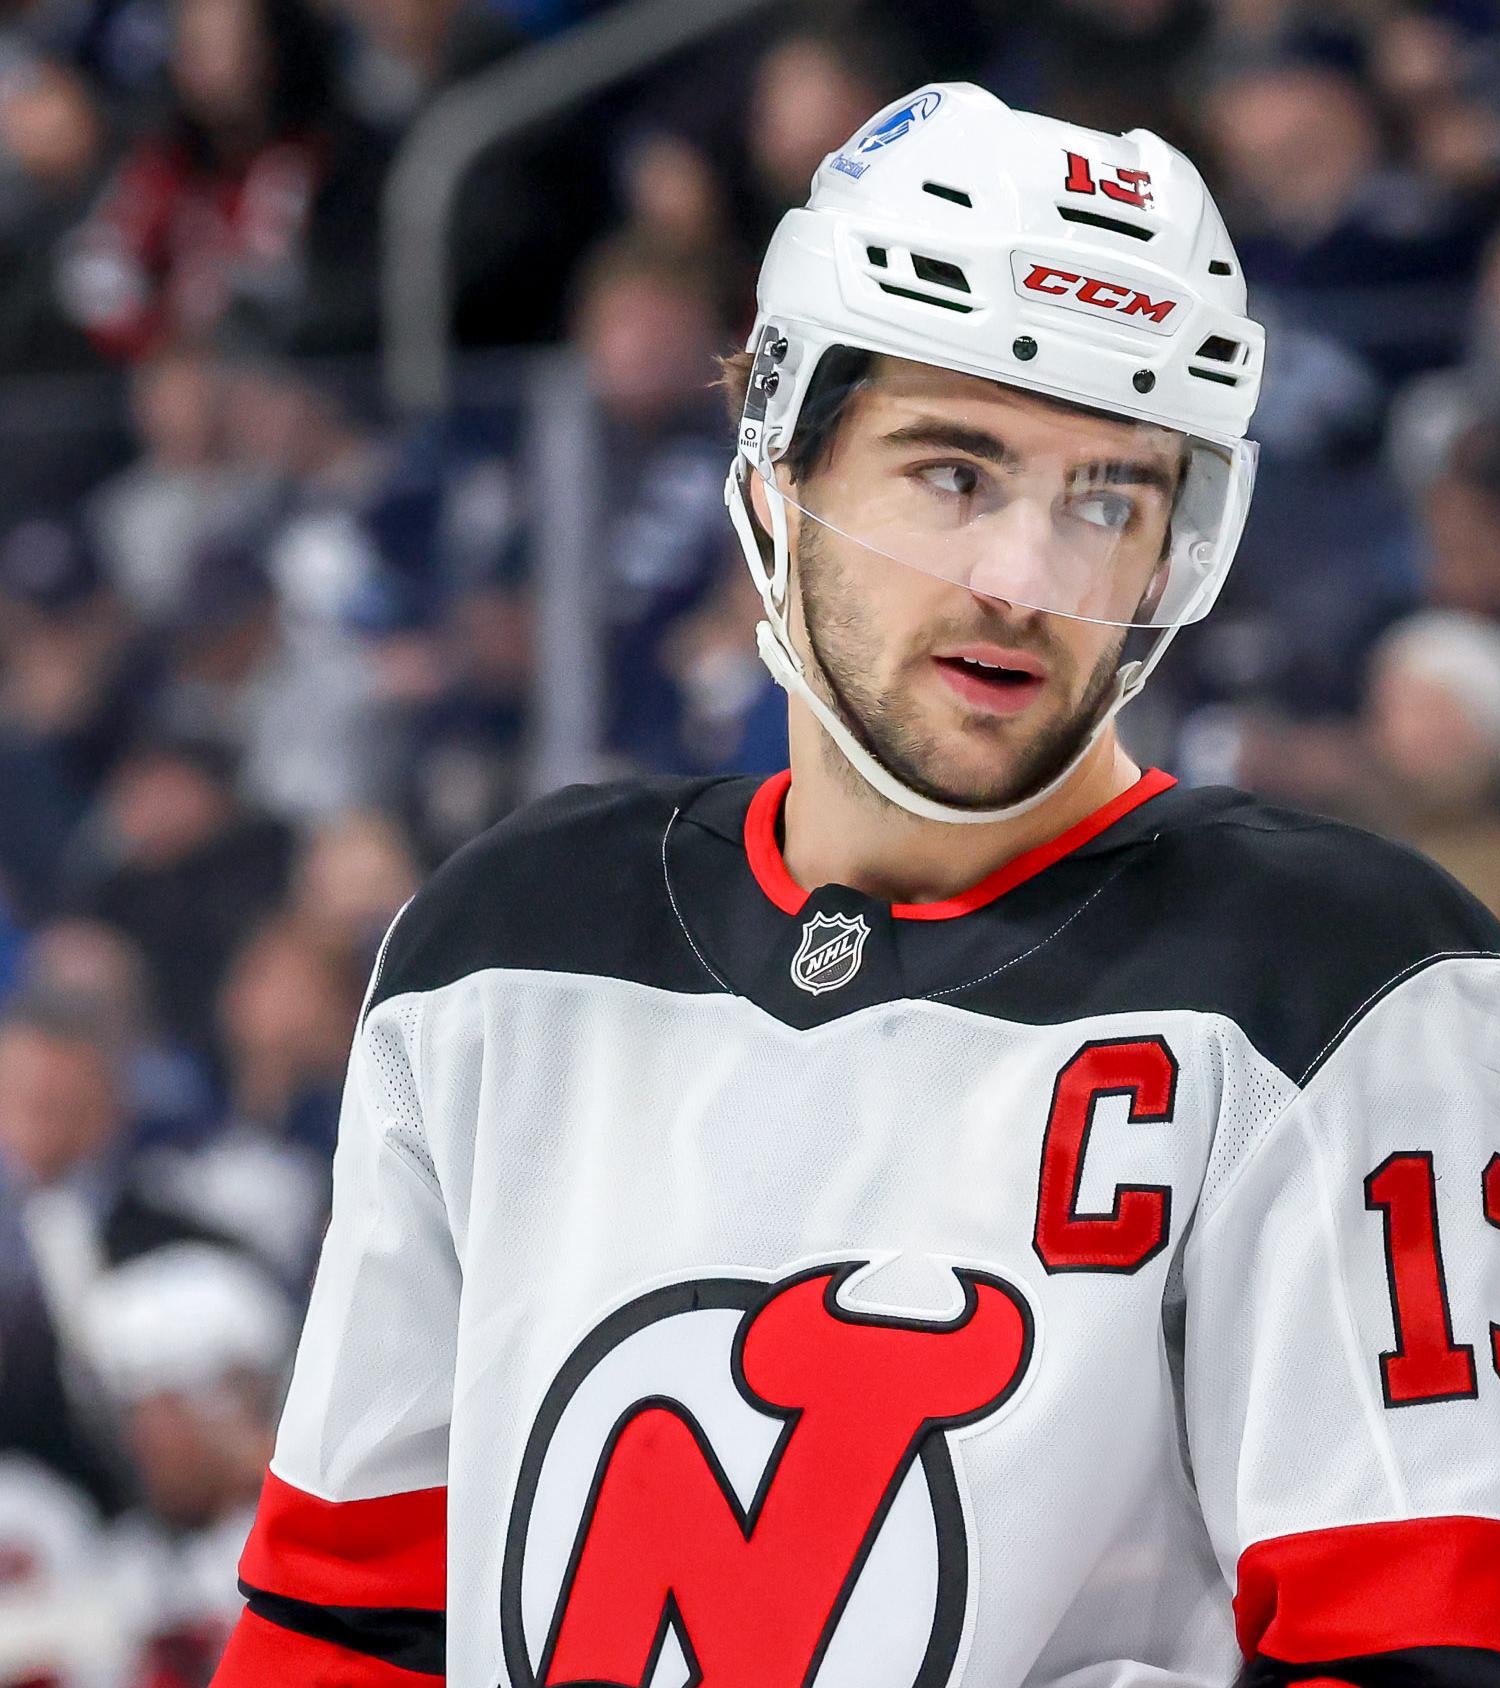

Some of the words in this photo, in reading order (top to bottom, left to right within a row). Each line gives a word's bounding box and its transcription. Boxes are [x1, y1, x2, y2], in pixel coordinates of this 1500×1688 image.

[1023, 264, 1177, 323] CCM
[806, 936, 853, 976] NHL
[1032, 1033, 1179, 1275] C
